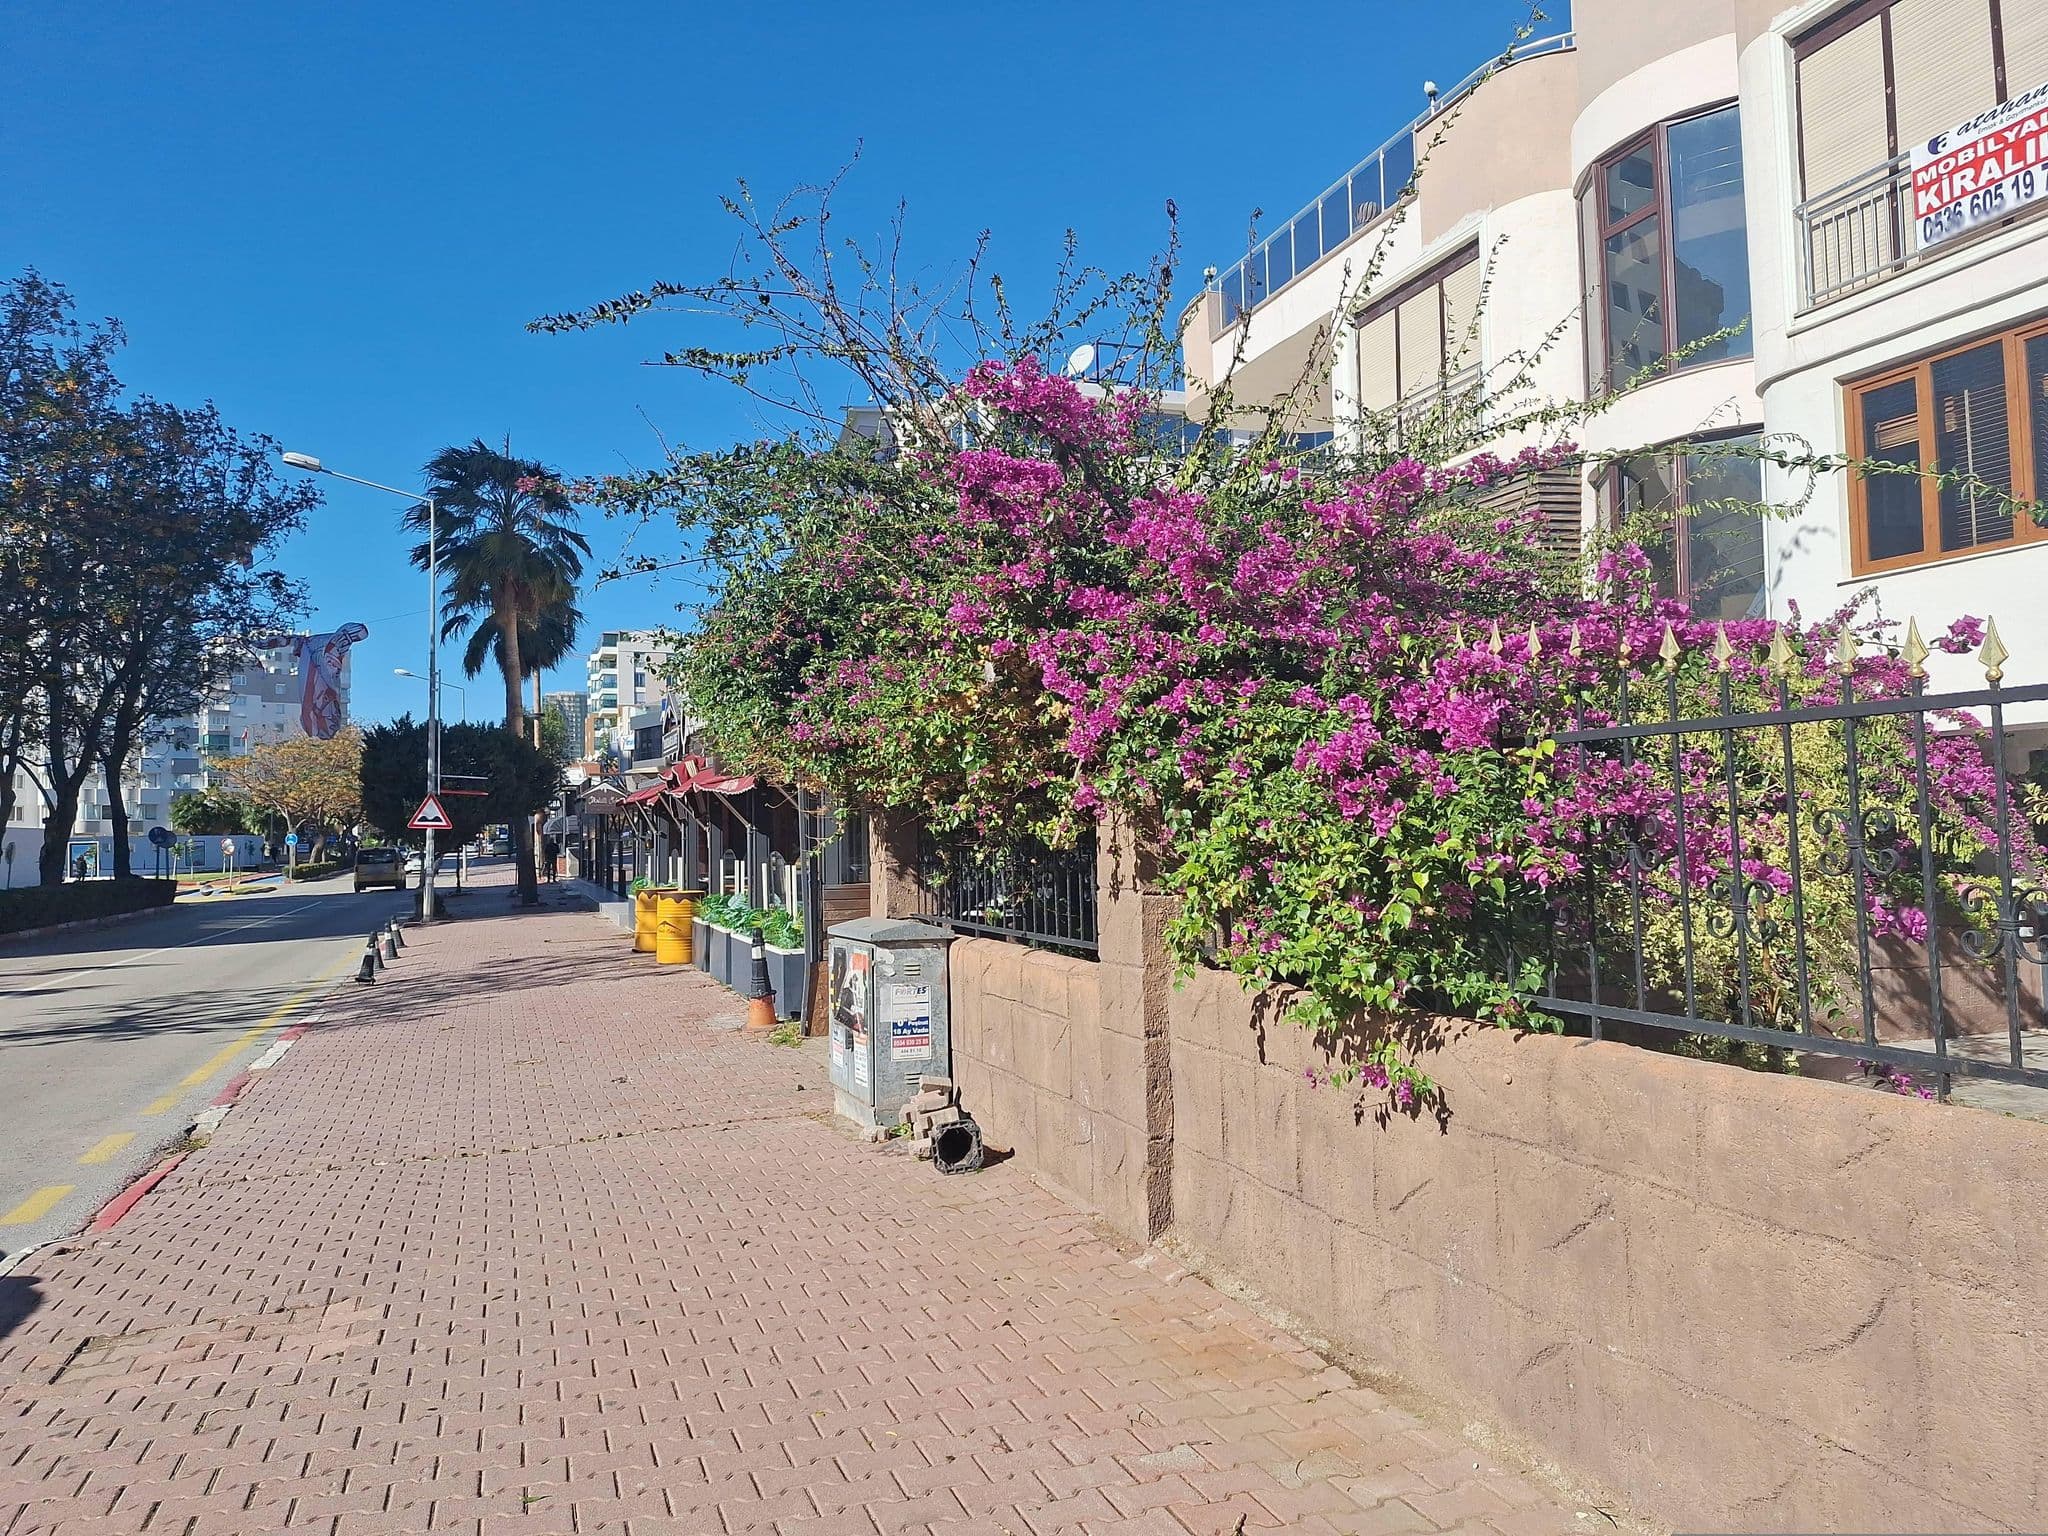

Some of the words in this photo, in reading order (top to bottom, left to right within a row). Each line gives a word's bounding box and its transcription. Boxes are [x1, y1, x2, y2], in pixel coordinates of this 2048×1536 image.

[1923, 201, 1963, 243] 0536
[1970, 183, 2004, 218] 605
[2011, 170, 2034, 199] 19
